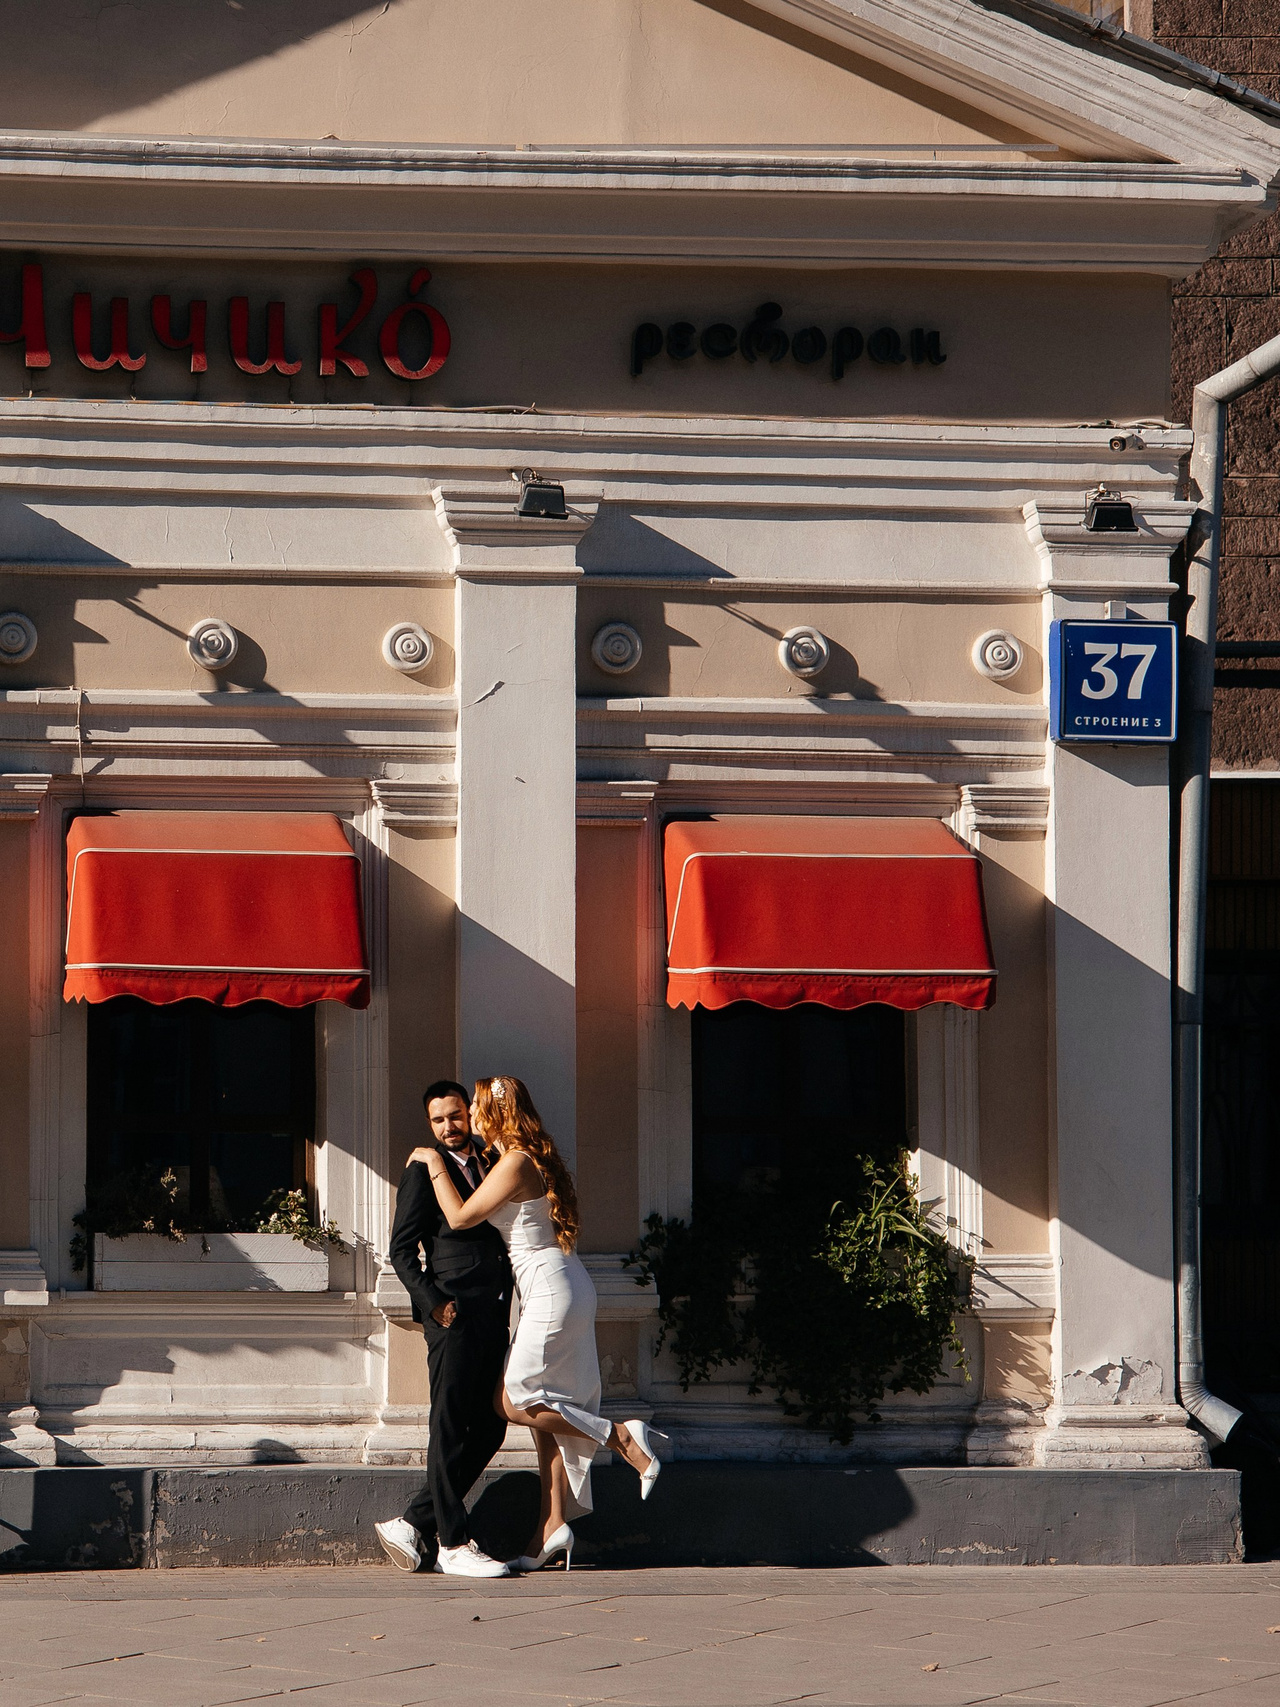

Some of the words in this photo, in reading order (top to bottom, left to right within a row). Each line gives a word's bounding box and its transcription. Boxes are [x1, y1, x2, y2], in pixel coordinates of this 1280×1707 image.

[631, 301, 947, 381] ресторан
[1081, 642, 1157, 700] 37
[1074, 716, 1149, 727] СТРОЕНИЕ
[1154, 718, 1162, 728] 3
